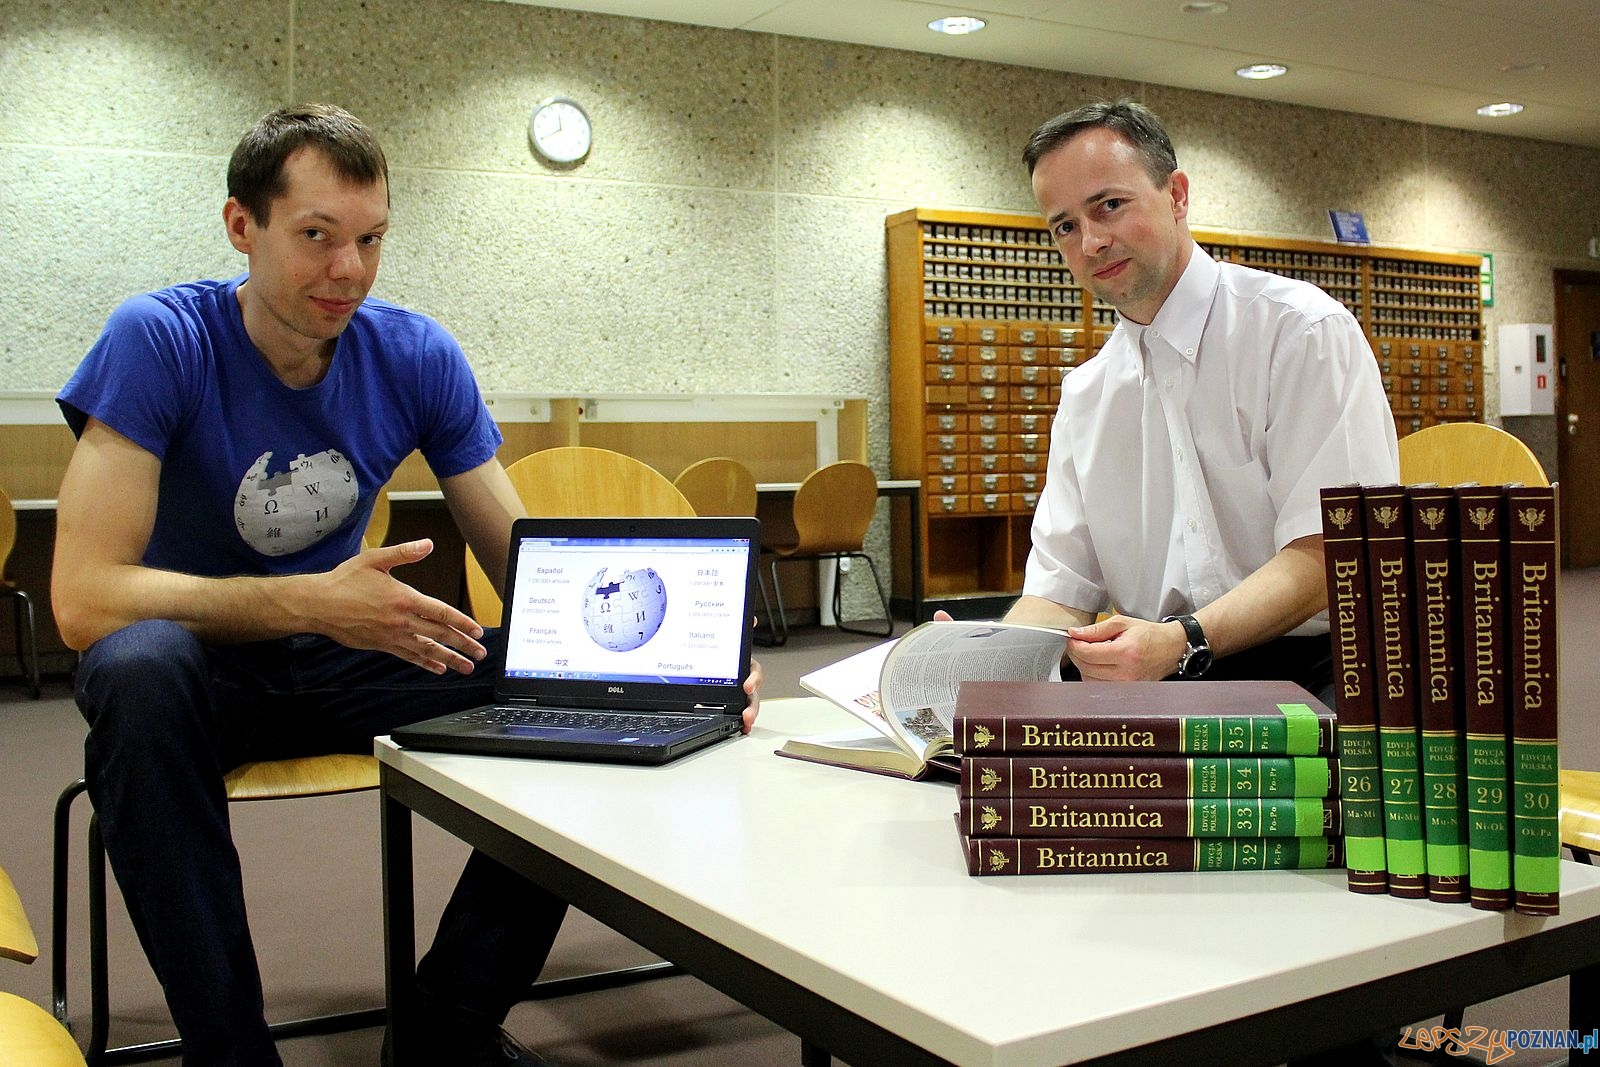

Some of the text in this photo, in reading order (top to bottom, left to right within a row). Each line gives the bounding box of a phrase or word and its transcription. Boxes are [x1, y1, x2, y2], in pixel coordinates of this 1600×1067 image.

[305, 482, 320, 496] W
[264, 500, 279, 515] Ω
[315, 507, 328, 522] И
[536, 567, 563, 575] Español
[528, 597, 556, 605] Deutsch
[628, 591, 640, 601] W
[600, 602, 611, 613] Ω
[528, 628, 557, 636] Français
[1334, 558, 1366, 698] Britannica
[1380, 558, 1411, 700] Britannica
[1424, 559, 1455, 702] Britannica
[1473, 560, 1502, 706] Britannica
[688, 632, 715, 640] Italiano
[1522, 562, 1550, 710] Britannica
[555, 659, 568, 667] 中文
[657, 662, 694, 672] Português
[608, 686, 624, 694] DELL
[1022, 724, 1156, 748] Britannica
[1228, 726, 1244, 749] 35
[1343, 740, 1372, 748] EDYCJA
[1386, 741, 1415, 749] EDYCJA
[1343, 748, 1372, 756] POLSKA
[1386, 748, 1417, 758] POLSKA
[1474, 748, 1504, 757] EDYCJA
[1521, 754, 1552, 762] EDYCJA
[1474, 757, 1505, 766] POLSKA
[1520, 762, 1553, 771] POLSKA
[1028, 766, 1163, 789] Britannica
[1236, 767, 1252, 790] 34
[1348, 776, 1372, 792] 26
[1390, 778, 1414, 795] 27
[1433, 783, 1457, 799] 28
[1477, 787, 1504, 804] 29
[1524, 792, 1550, 810] 30
[1029, 805, 1163, 828] Britannica
[1209, 804, 1217, 832] POLSKA
[1236, 807, 1252, 830] 33
[1269, 806, 1277, 832] Po-Po
[1036, 845, 1169, 868] Britannica
[1242, 844, 1257, 865] 32
